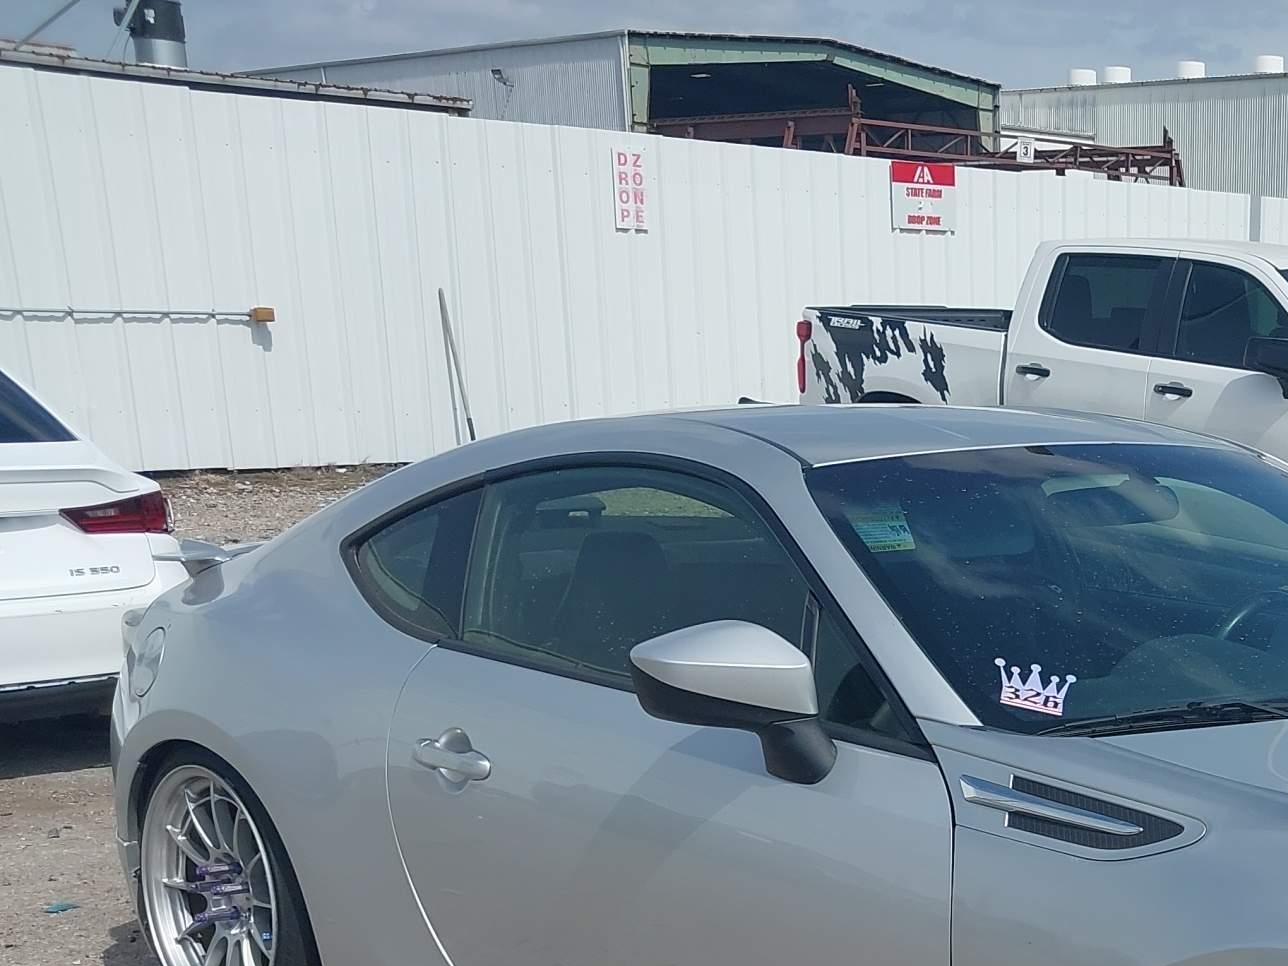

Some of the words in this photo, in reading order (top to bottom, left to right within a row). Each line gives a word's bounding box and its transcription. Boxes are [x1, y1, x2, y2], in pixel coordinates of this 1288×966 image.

[1022, 145, 1029, 157] 3
[905, 186, 925, 198] STATE
[925, 188, 943, 199] FARM
[907, 214, 925, 225] DROP
[925, 215, 942, 226] ZONE
[1004, 685, 1061, 709] 326
